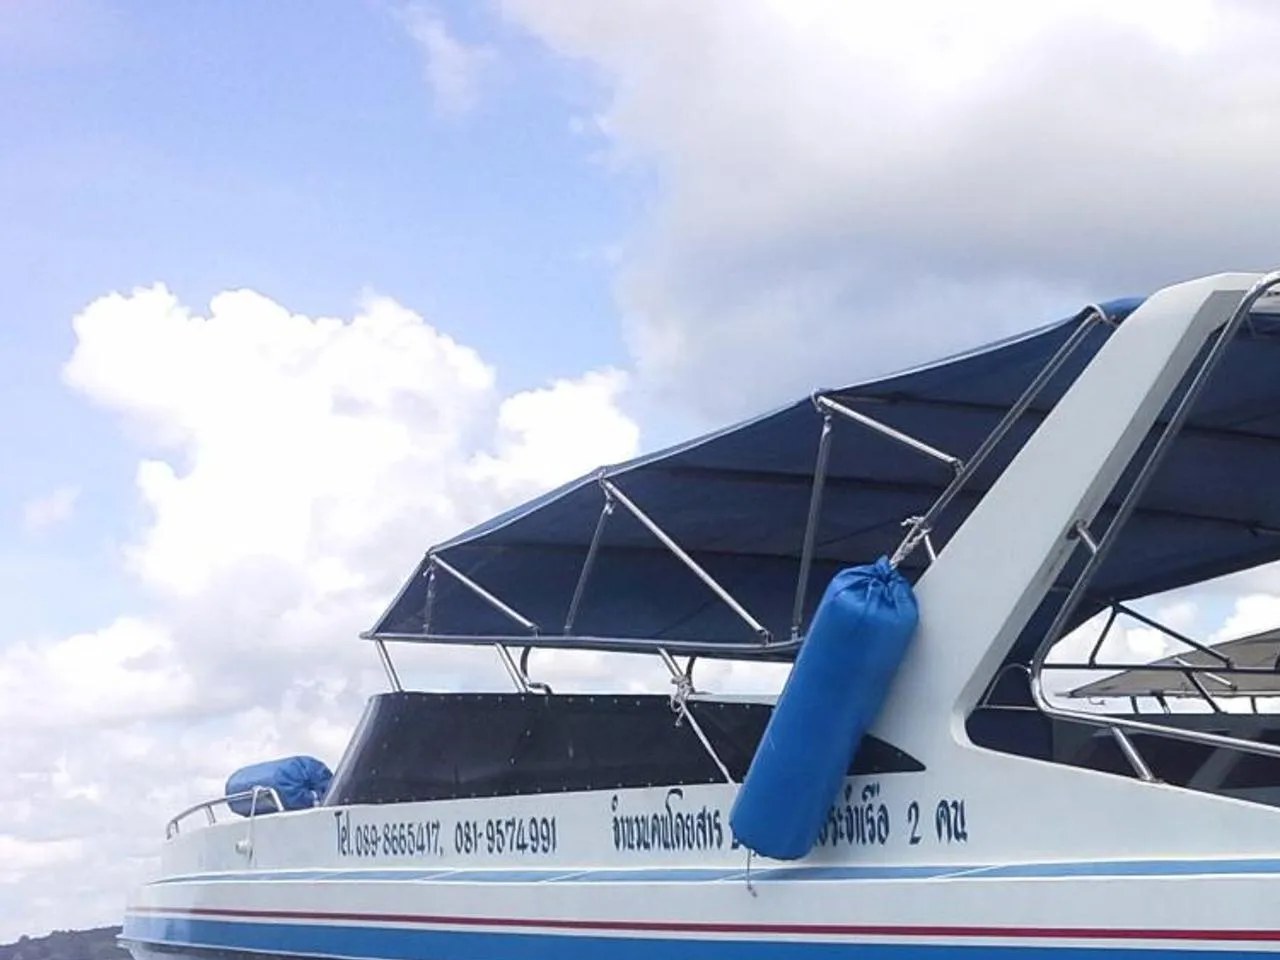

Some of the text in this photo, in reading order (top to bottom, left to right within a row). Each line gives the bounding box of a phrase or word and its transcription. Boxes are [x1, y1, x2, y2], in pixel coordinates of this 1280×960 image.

[454, 816, 557, 854] 081-9574991
[907, 800, 921, 845] 2
[935, 799, 968, 843] คน
